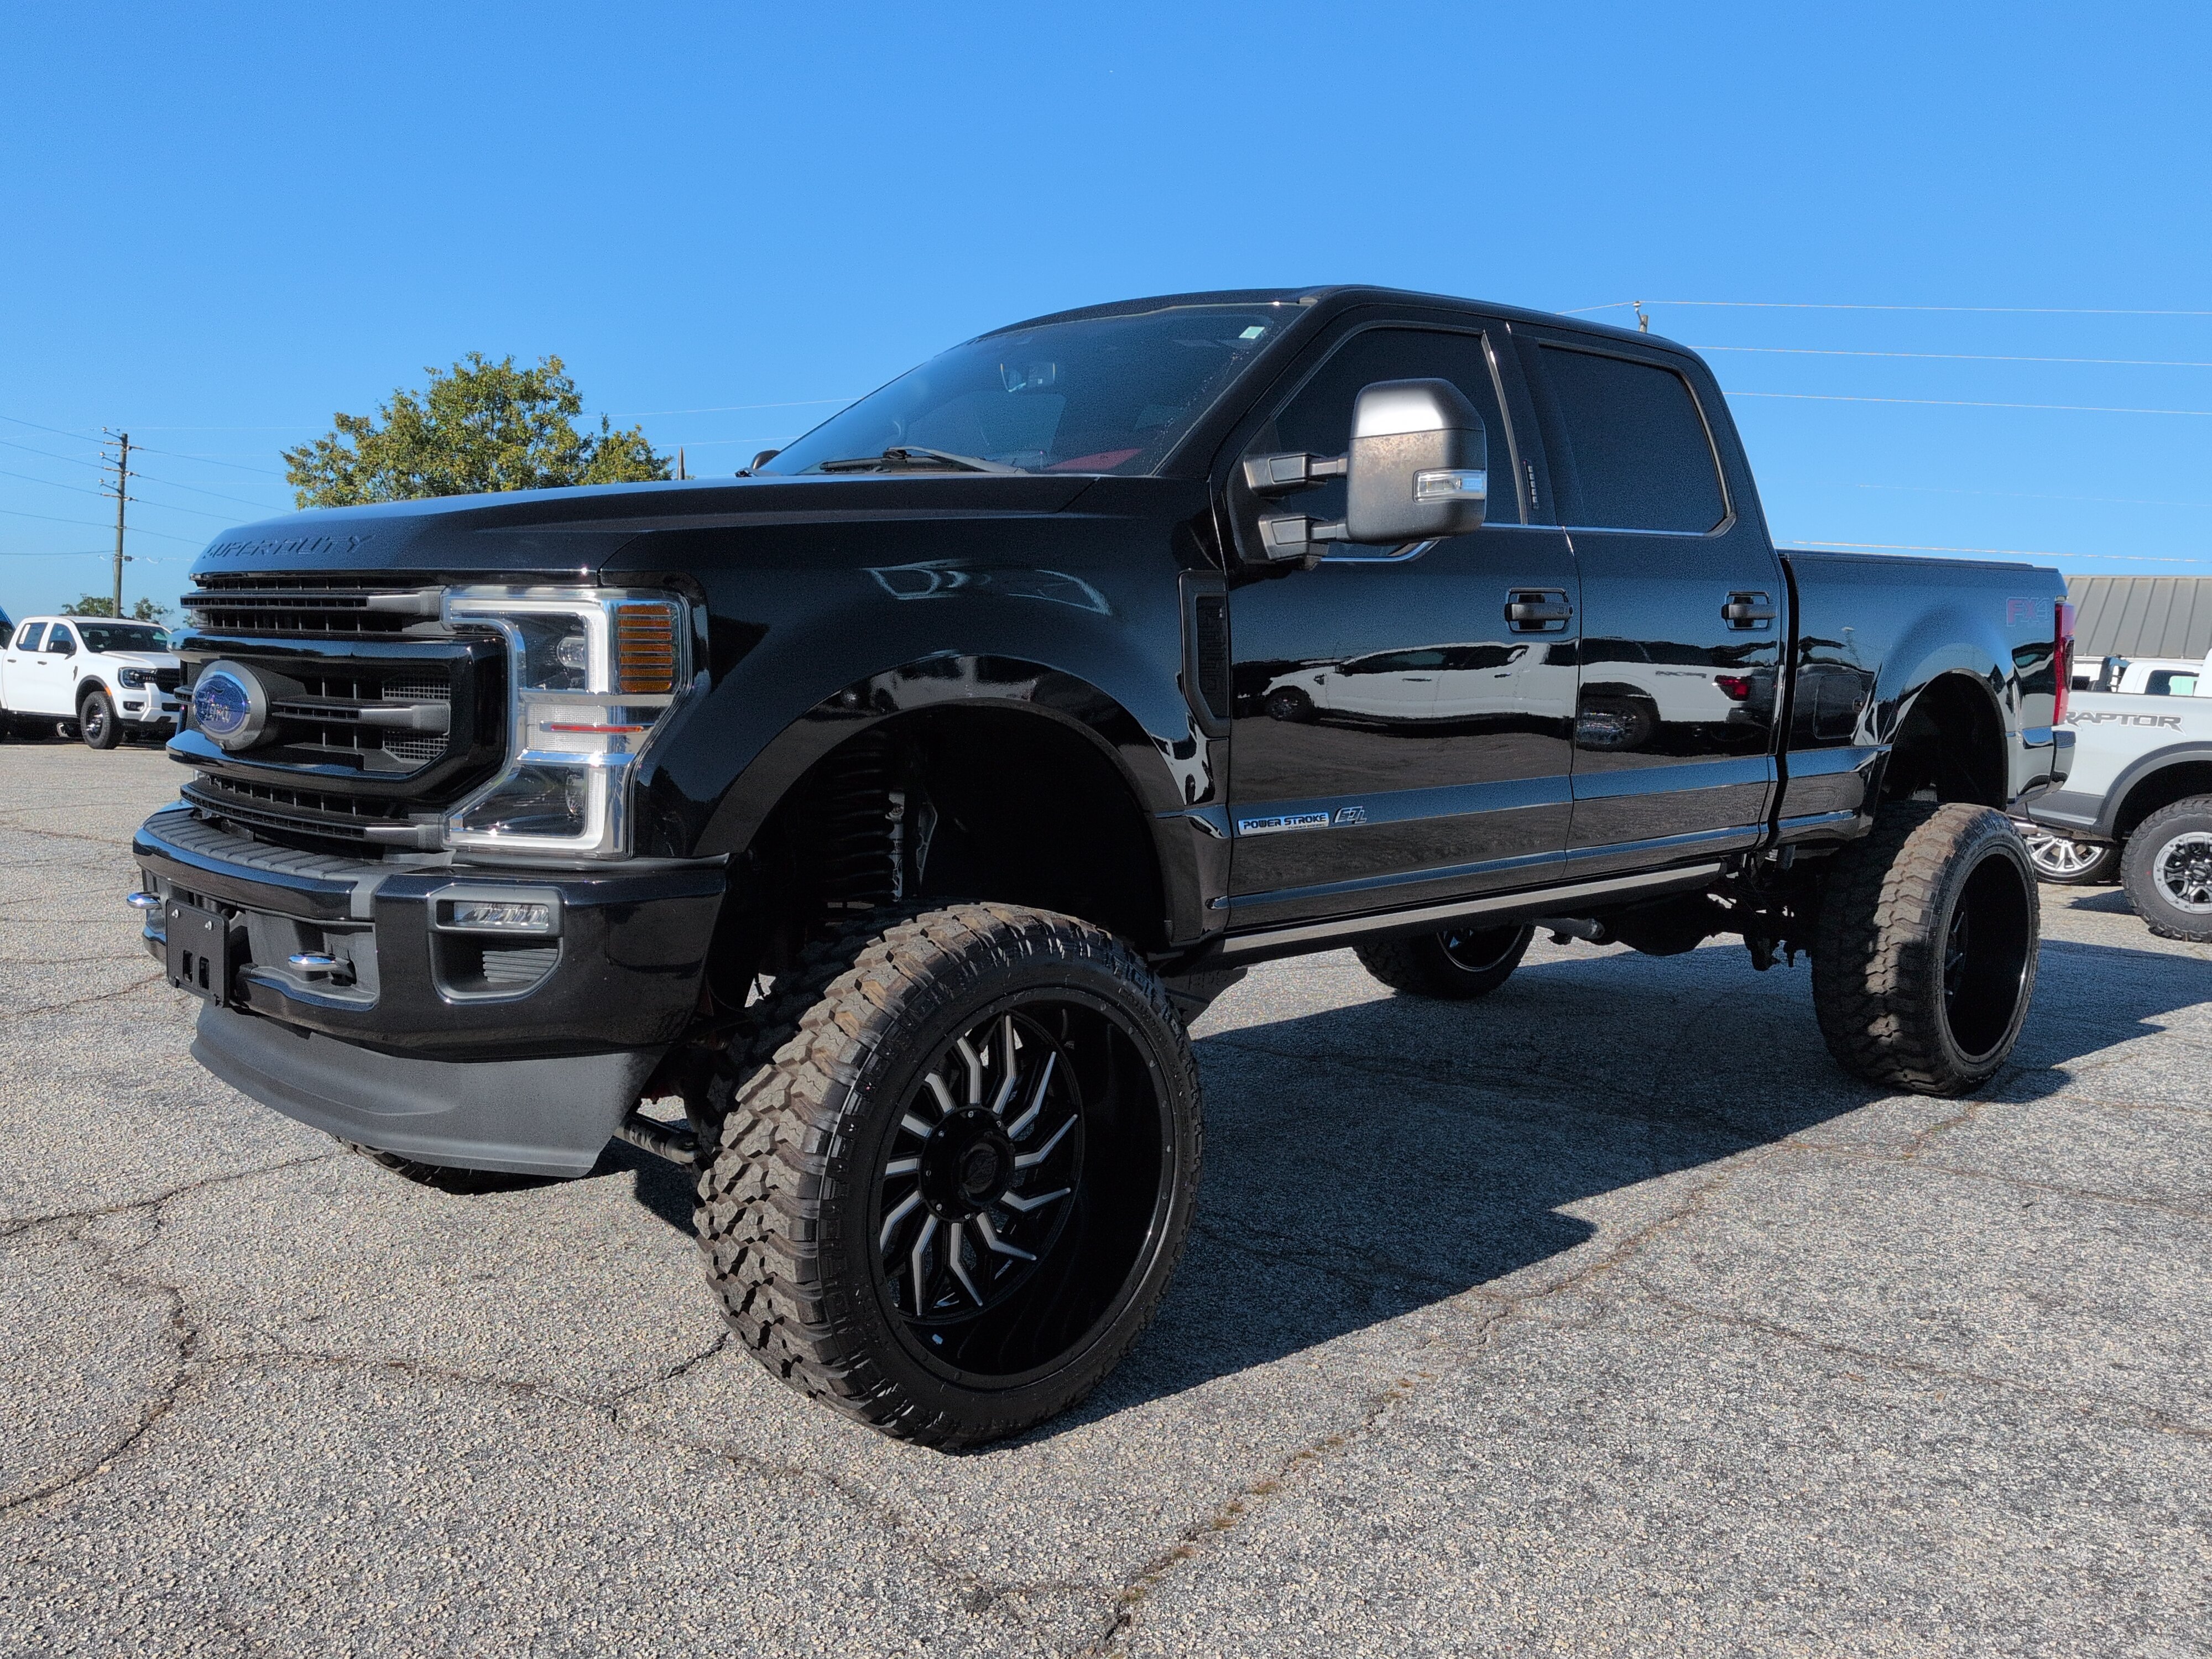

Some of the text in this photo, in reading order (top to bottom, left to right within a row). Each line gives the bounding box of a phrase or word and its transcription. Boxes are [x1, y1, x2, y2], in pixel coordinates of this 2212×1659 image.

[274, 534, 375, 555] DUTY
[2006, 597, 2049, 626] FX4
[1243, 814, 1326, 830] POWER STROKE
